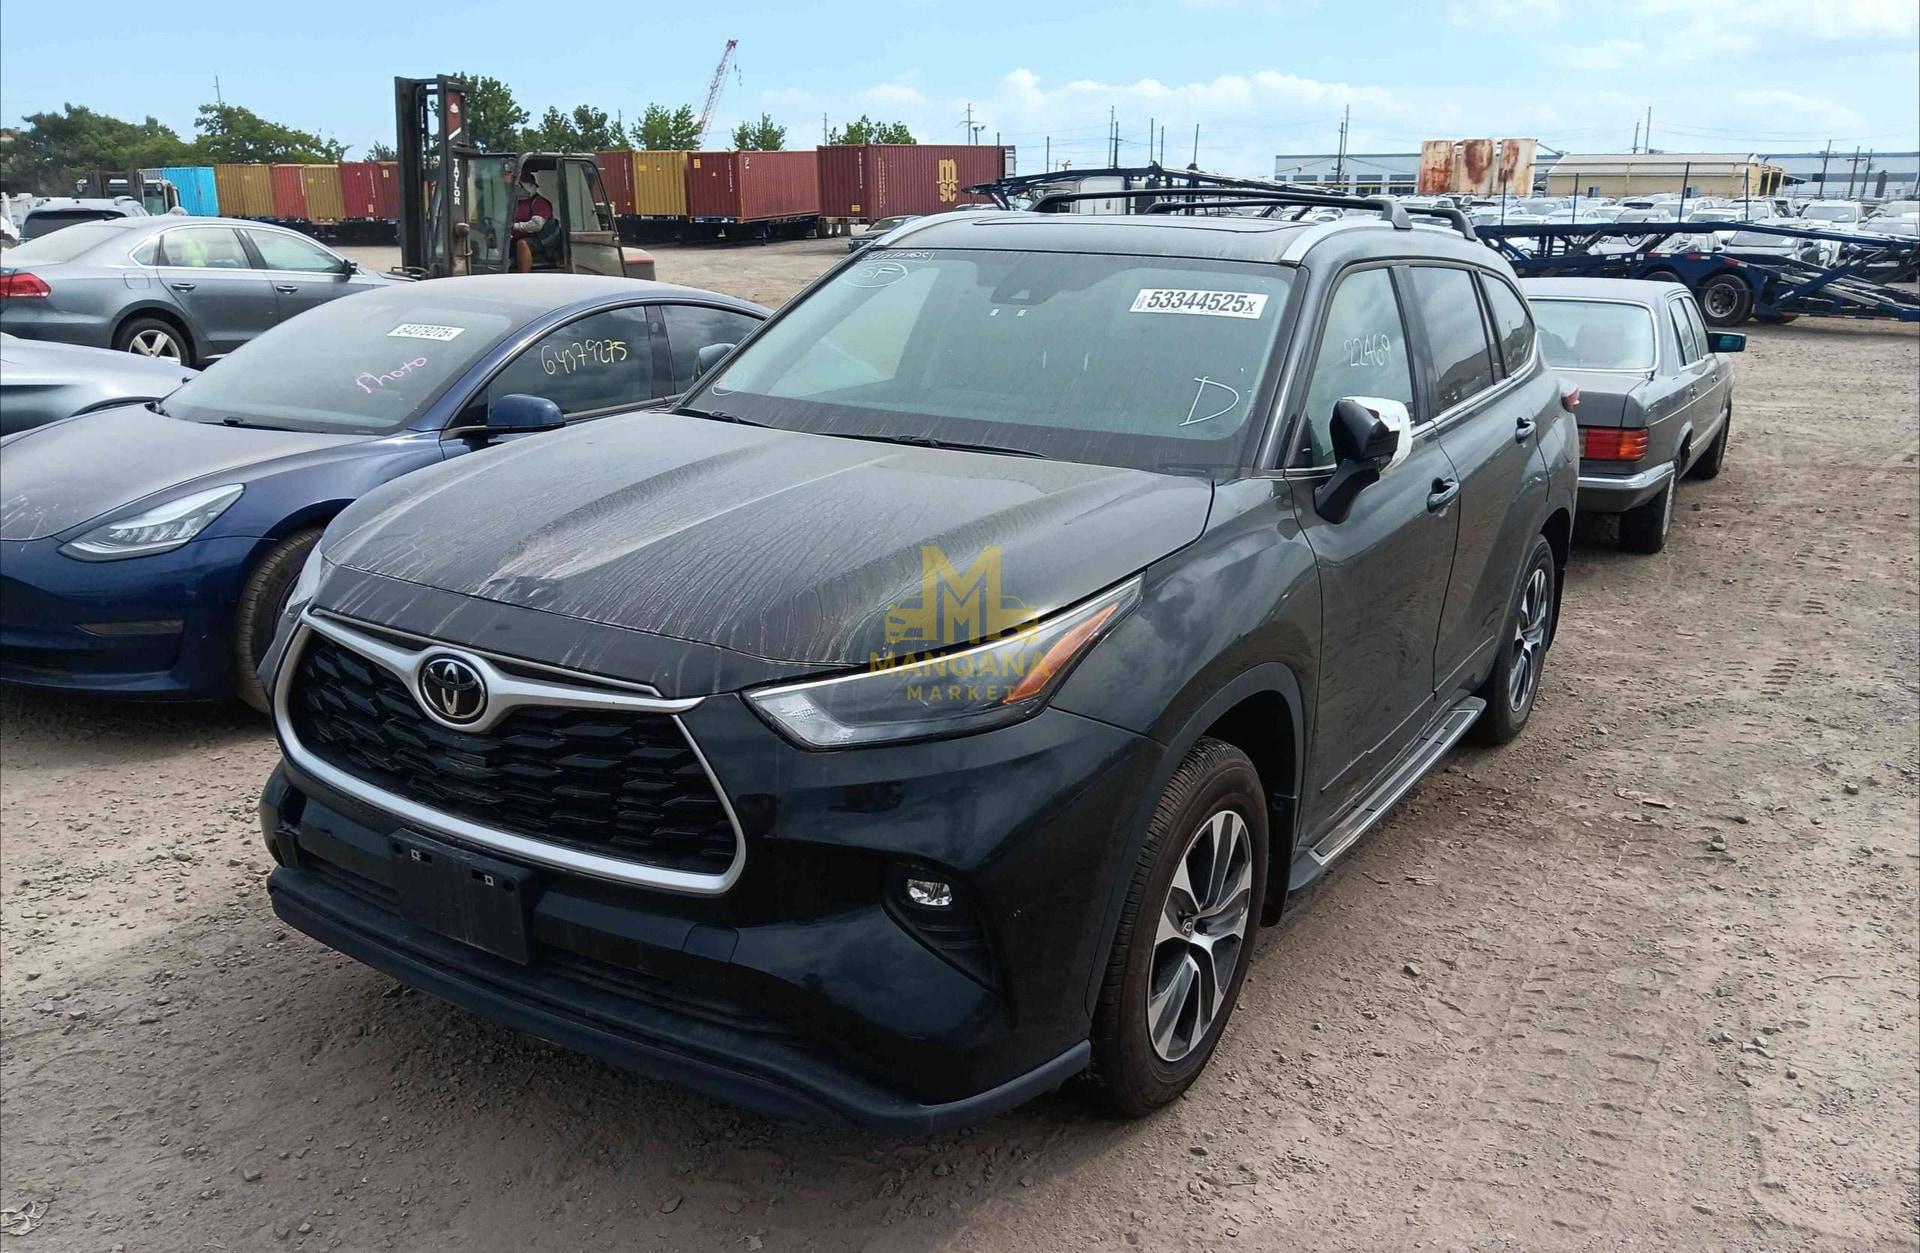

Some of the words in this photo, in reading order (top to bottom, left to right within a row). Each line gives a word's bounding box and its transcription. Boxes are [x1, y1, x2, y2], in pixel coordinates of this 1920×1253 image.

[453, 158, 461, 206] TAYLOR
[541, 339, 627, 375] 64379275
[1344, 334, 1392, 367] 22469
[1179, 376, 1240, 427] D
